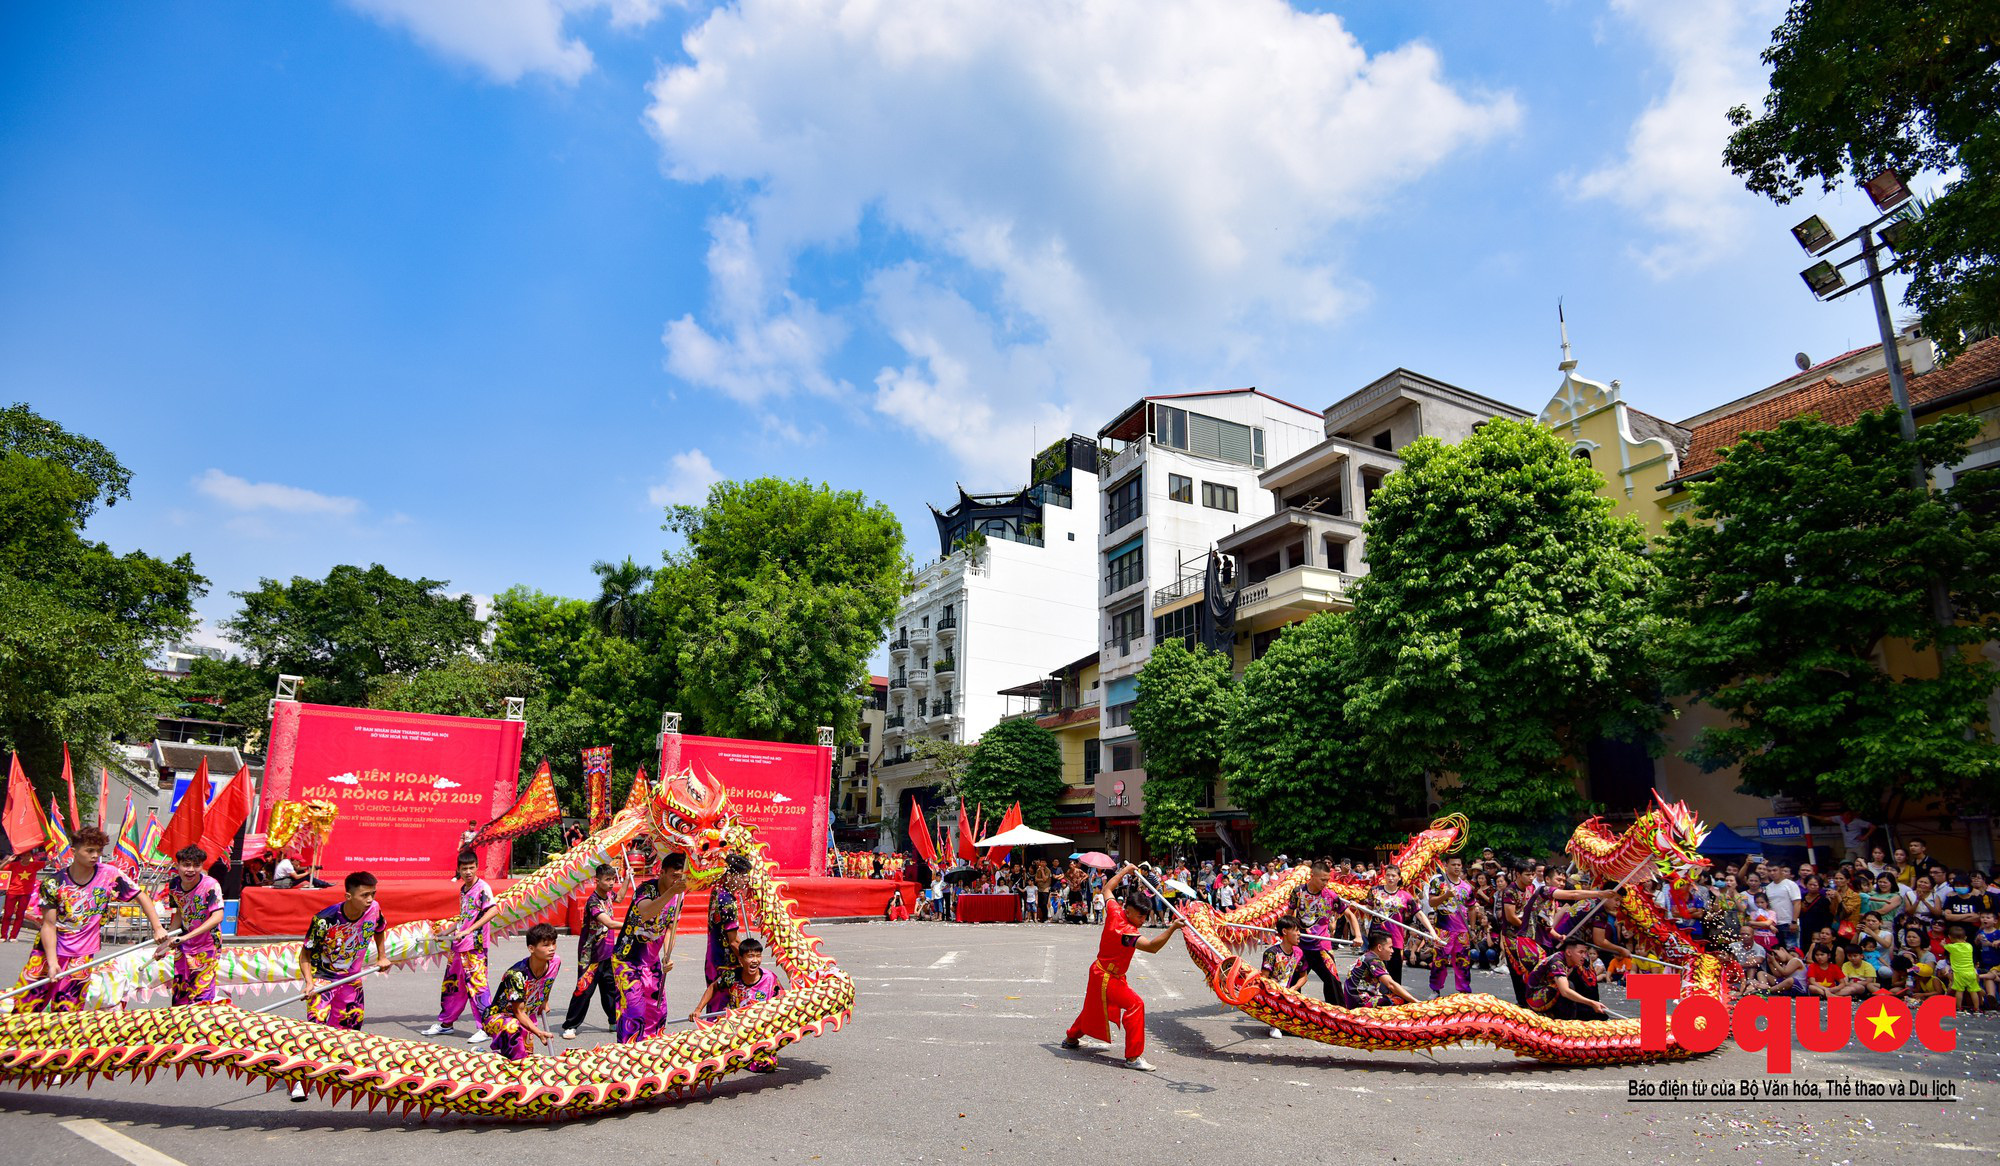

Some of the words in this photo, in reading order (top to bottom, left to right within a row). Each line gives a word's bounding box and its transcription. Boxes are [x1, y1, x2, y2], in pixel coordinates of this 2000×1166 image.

[356, 768, 390, 782] LIÊN
[395, 772, 439, 784] HOAN
[302, 784, 337, 798] MÚA
[342, 784, 389, 800] RỒNG
[393, 788, 415, 802] HÀ
[419, 789, 448, 805] NỘI
[451, 792, 482, 804] 2019
[726, 787, 744, 798] IÊN
[747, 790, 776, 799] HOAN
[746, 802, 761, 813] HÀ
[764, 803, 783, 816] NỘI
[785, 806, 806, 815] 2019
[1762, 826, 1783, 836] HÀNG
